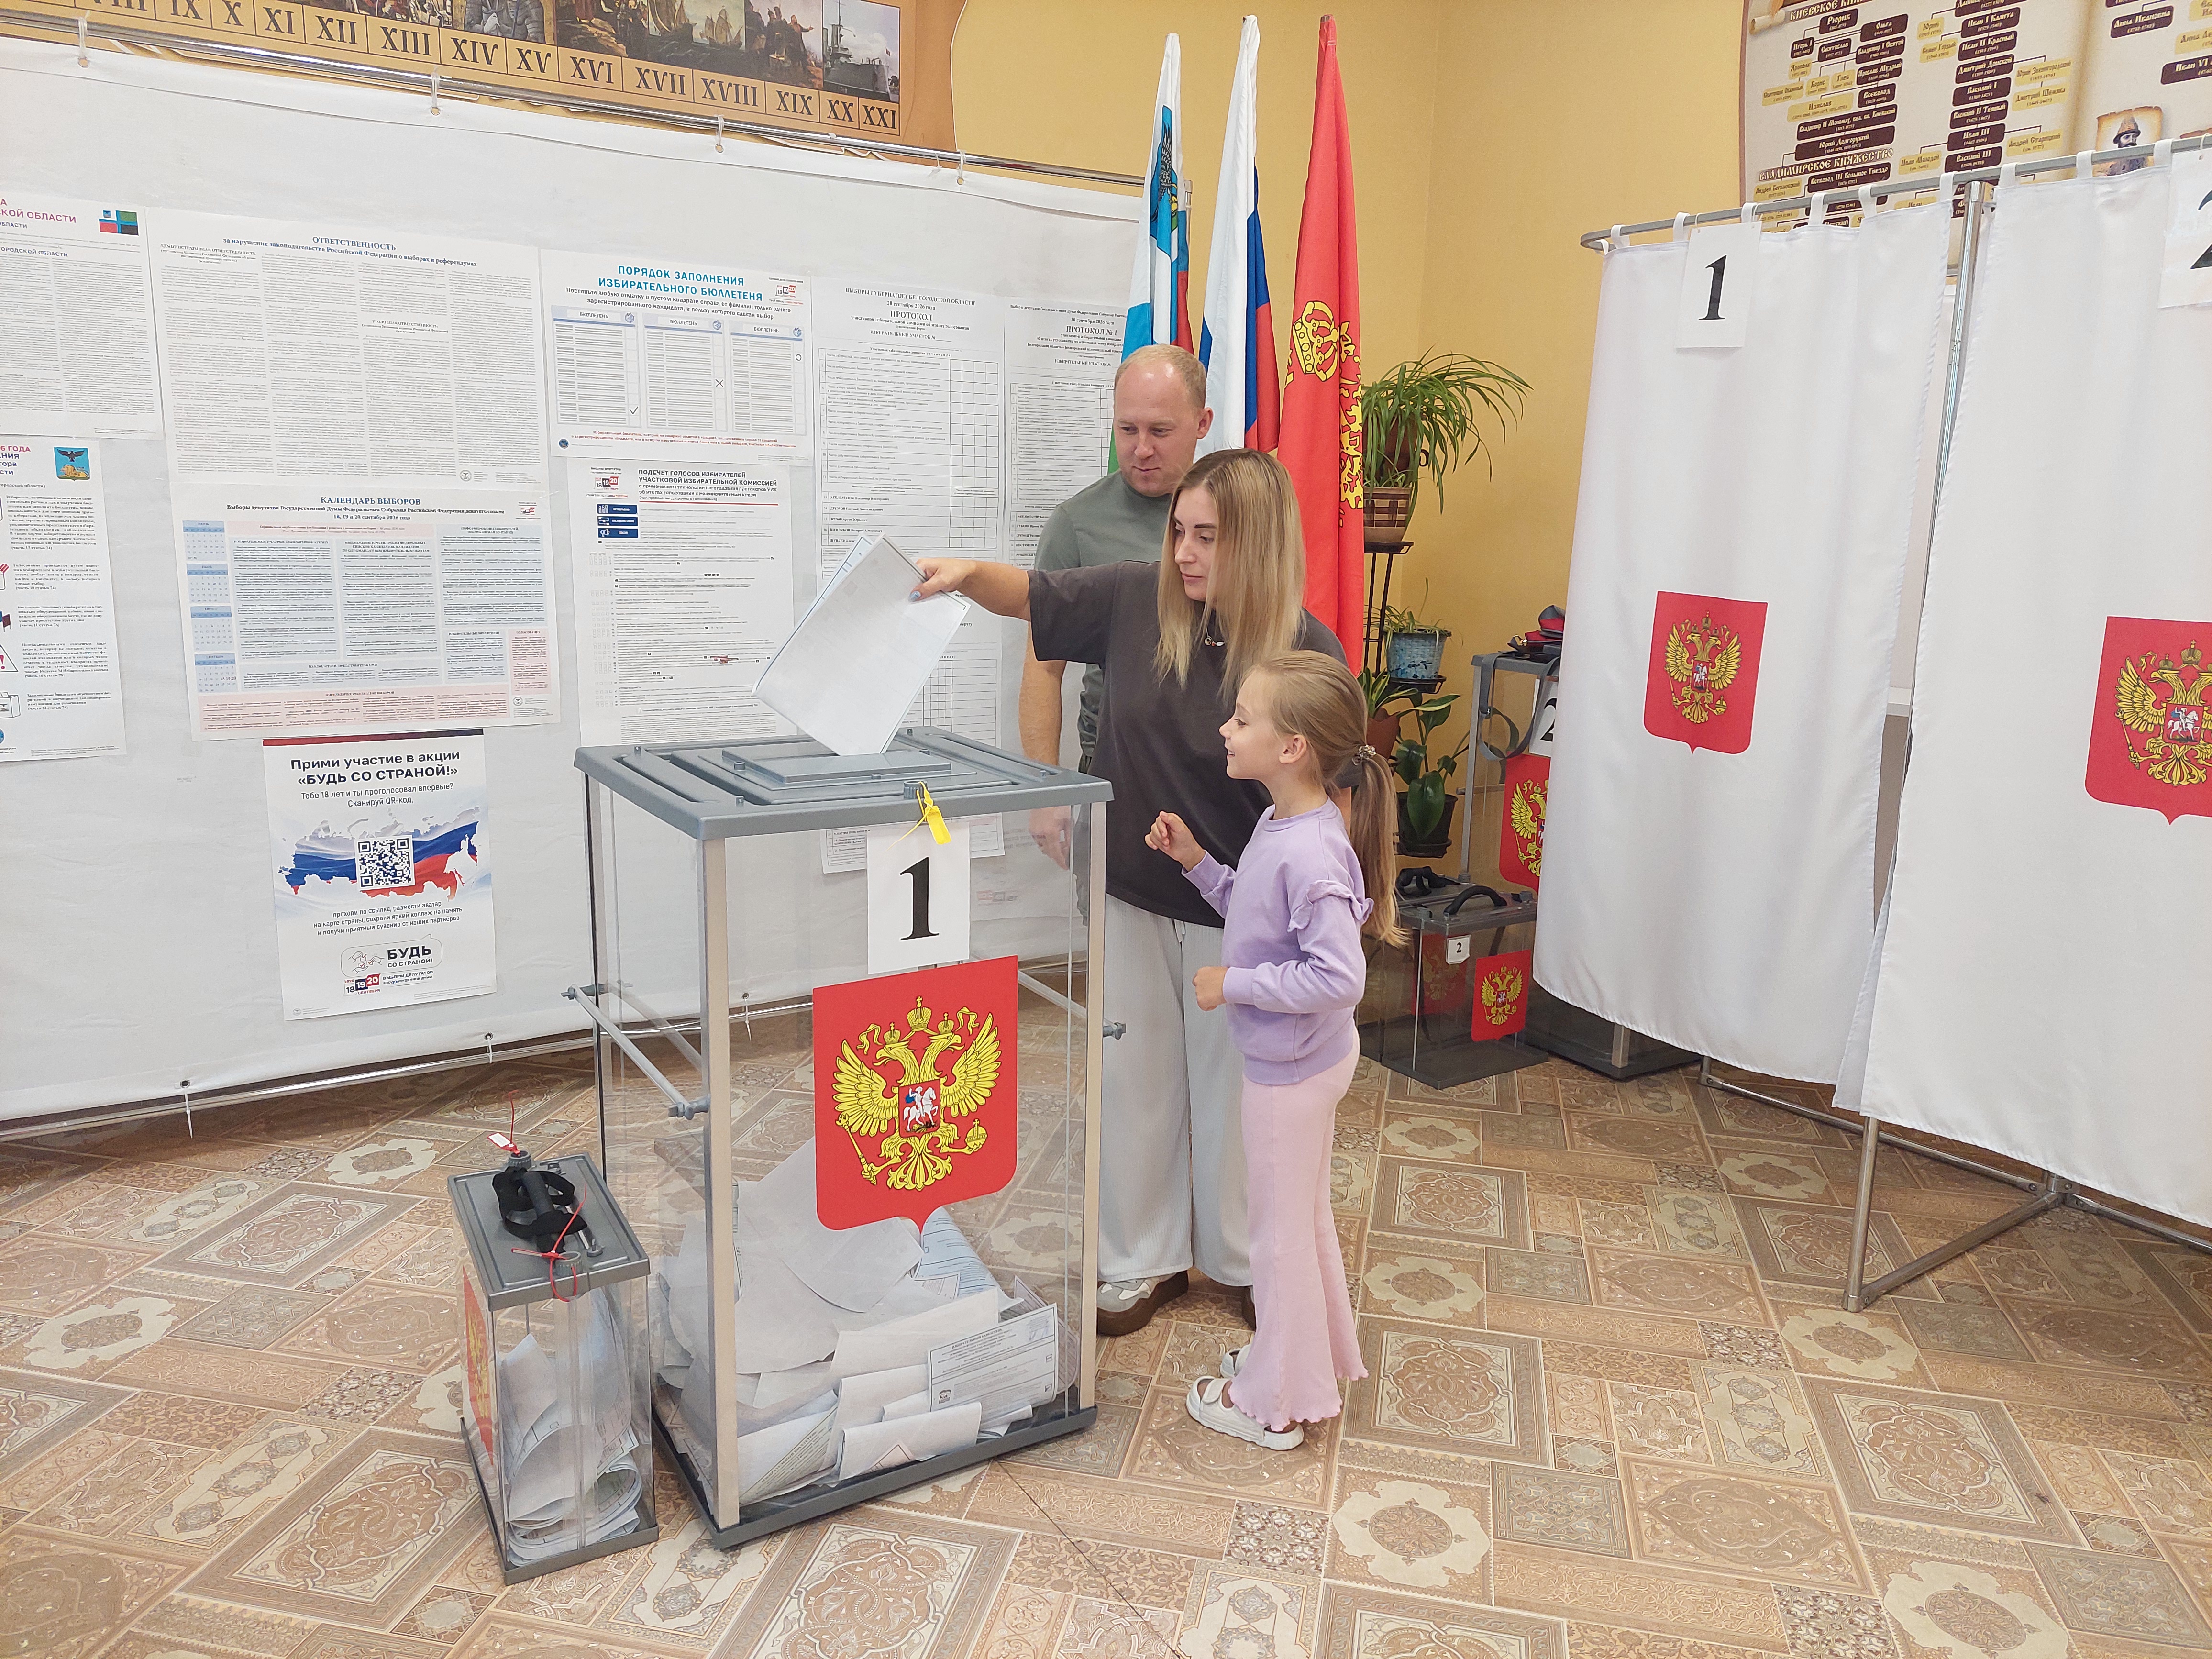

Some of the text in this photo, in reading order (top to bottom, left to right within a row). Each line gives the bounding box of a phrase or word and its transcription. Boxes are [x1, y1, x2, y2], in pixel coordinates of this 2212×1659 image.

[222, 0, 244, 26] X
[264, 8, 295, 34] XI
[1827, 13, 1851, 26] Рюрик
[317, 15, 357, 44] XII
[380, 26, 431, 56] XIII
[450, 36, 498, 66] XIV
[515, 47, 552, 74] XV
[570, 57, 613, 84] XVI
[2199, 58, 2208, 66] VI
[635, 66, 686, 96] XVII
[700, 77, 758, 108] XVIII
[776, 89, 813, 116] XIX
[826, 99, 853, 123] XX
[861, 105, 896, 131] XXI
[1834, 148, 1893, 168] КНЯЖЕСТВО
[27, 212, 76, 223] ОБЛАСТИ
[312, 237, 396, 251] ОТВЕТСТВЕННОСТЬ
[270, 243, 325, 251] законодательства
[327, 247, 362, 255] Российской
[436, 258, 476, 266] референдумах
[619, 266, 743, 286] ПОРЯДОК ЗАПОЛНЕНИЯ
[599, 278, 762, 302] ИЗБИРАТЕЛЬНОГО БЮЛЛЕТЕНЯ
[1699, 255, 1726, 320] 1
[587, 298, 652, 308] зарегистрированного
[909, 295, 950, 303] БЕЛГОРОДСКОЙ
[890, 311, 932, 321] ПРОТОКОЛ
[1066, 326, 1104, 334] ПРОТОКОЛ
[291, 760, 340, 772] Прими
[344, 756, 402, 769] участие
[419, 752, 459, 762] акции
[299, 764, 457, 785] «БУДЬ СО СТРАНОЙ!»
[365, 787, 416, 796] проголосовал
[419, 783, 453, 792] впервые?
[348, 798, 383, 807] Сканируй
[393, 904, 420, 913] размести
[900, 857, 939, 940] 1
[346, 925, 375, 934] приятный
[387, 946, 432, 961] БУДЬ
[1455, 941, 1463, 954] 2
[399, 957, 432, 967] СТРАНОЙ!
